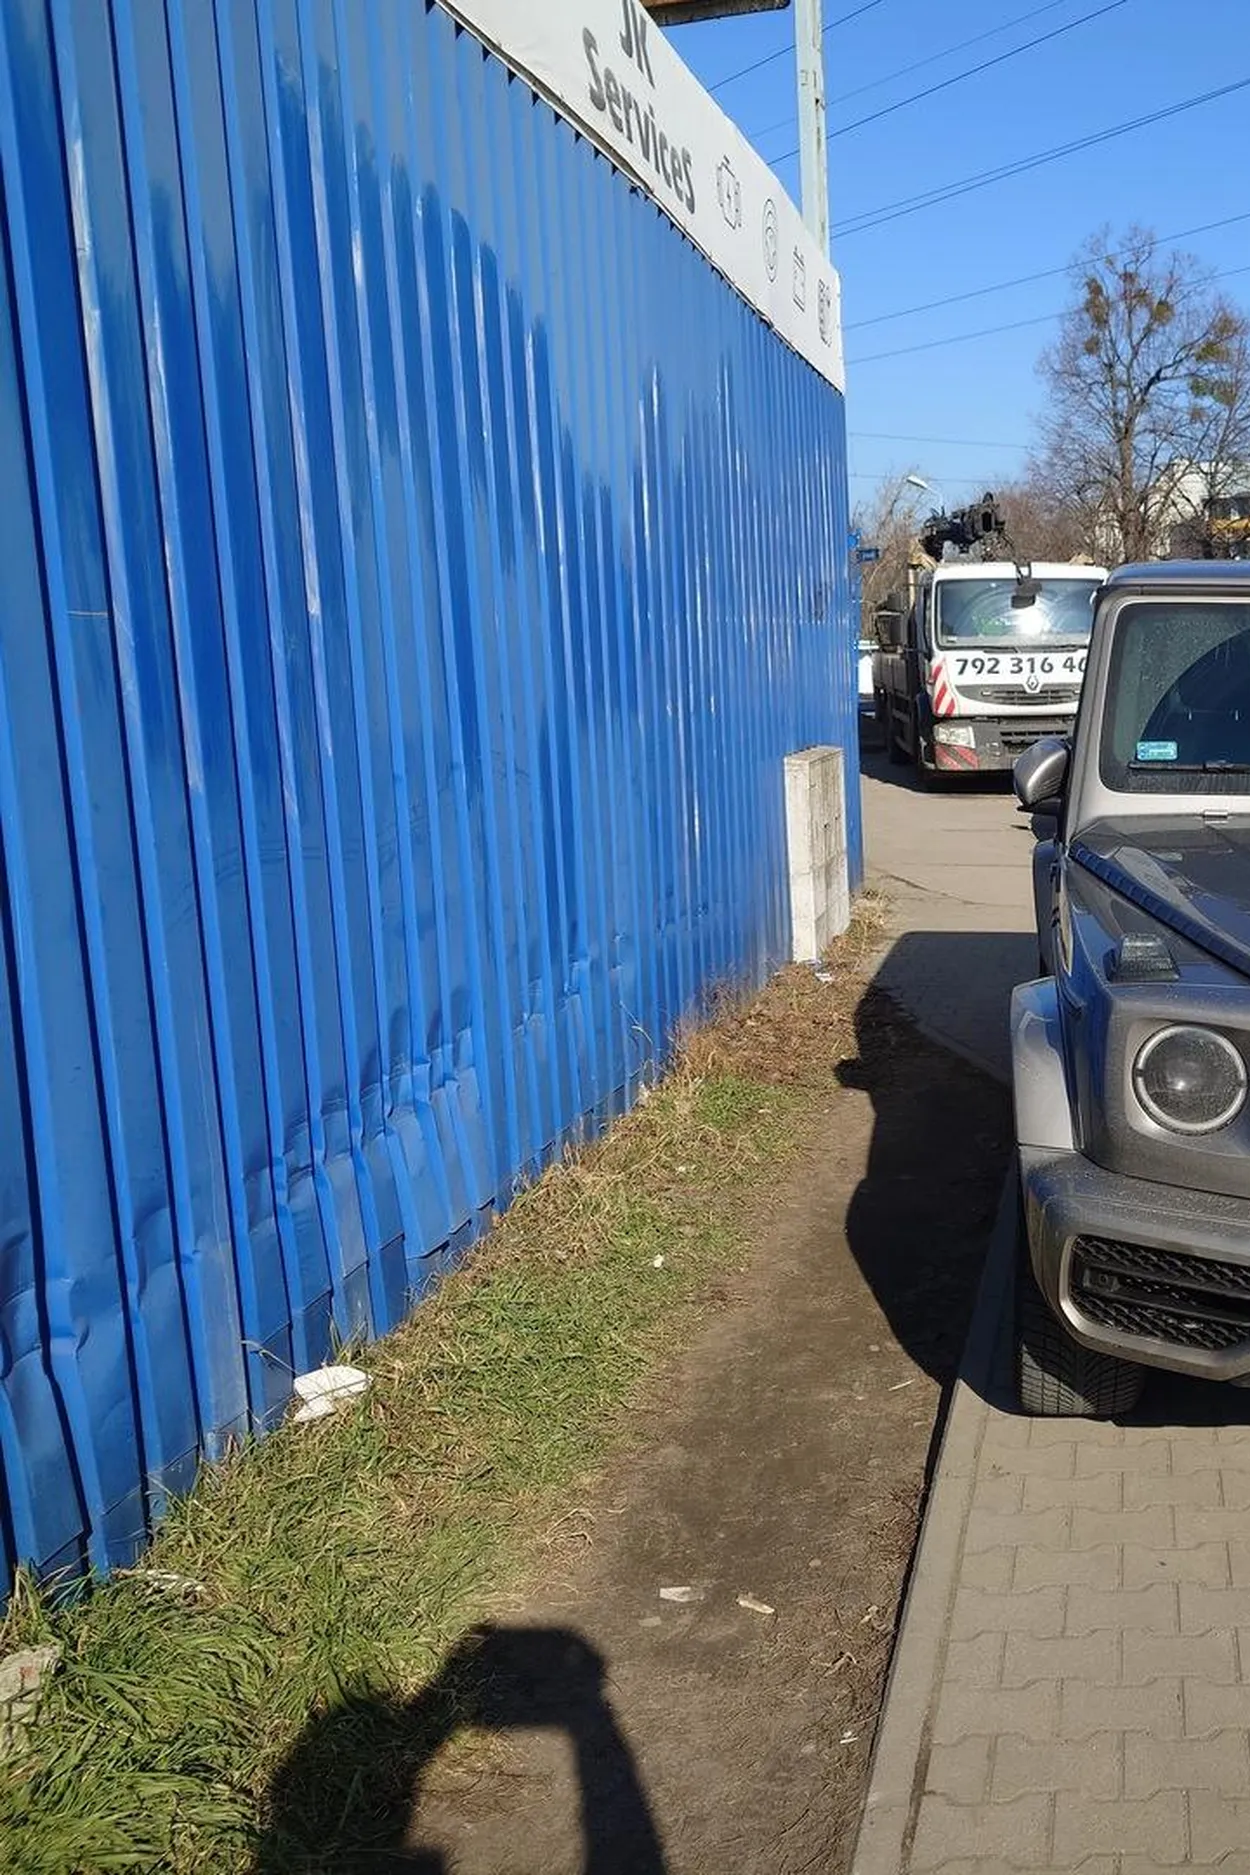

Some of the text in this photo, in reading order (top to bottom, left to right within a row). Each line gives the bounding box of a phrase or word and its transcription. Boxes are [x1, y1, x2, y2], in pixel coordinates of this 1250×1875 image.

[619, 0, 655, 89] JK
[582, 26, 696, 215] Services
[956, 657, 1000, 676] 792
[1009, 657, 1054, 674] 316
